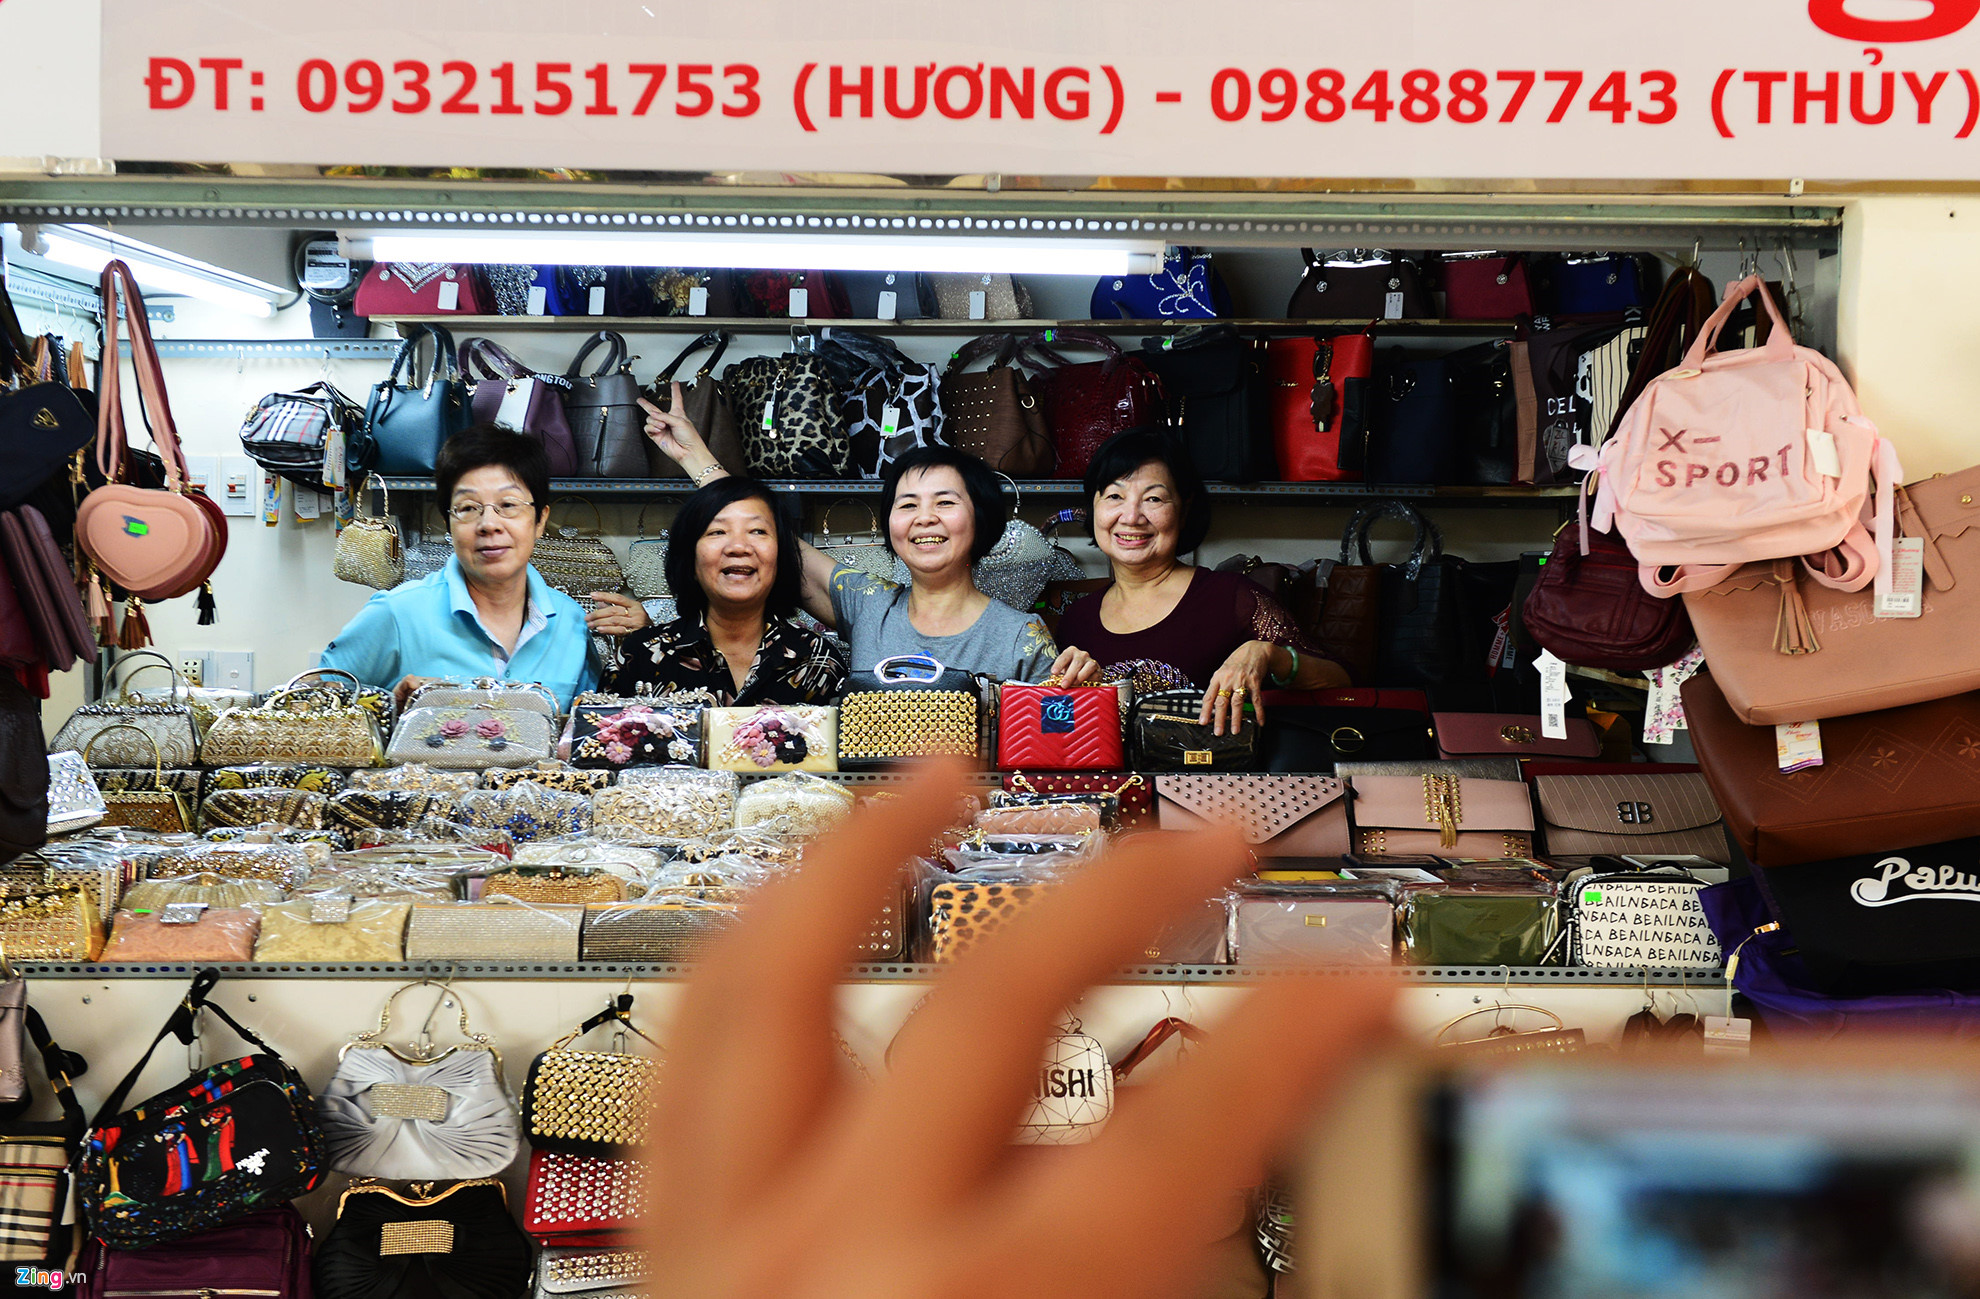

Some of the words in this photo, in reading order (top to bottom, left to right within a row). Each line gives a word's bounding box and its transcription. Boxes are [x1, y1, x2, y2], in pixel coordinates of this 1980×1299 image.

[144, 57, 264, 111] ĐT:
[296, 58, 761, 118] 0932151753
[793, 61, 1124, 134] (HƯƠNG)
[1210, 67, 1677, 124] 0984887743
[1710, 47, 1980, 139] (THỦY)
[1655, 443, 1793, 488] SPORT
[1034, 1068, 1096, 1098] ISHI
